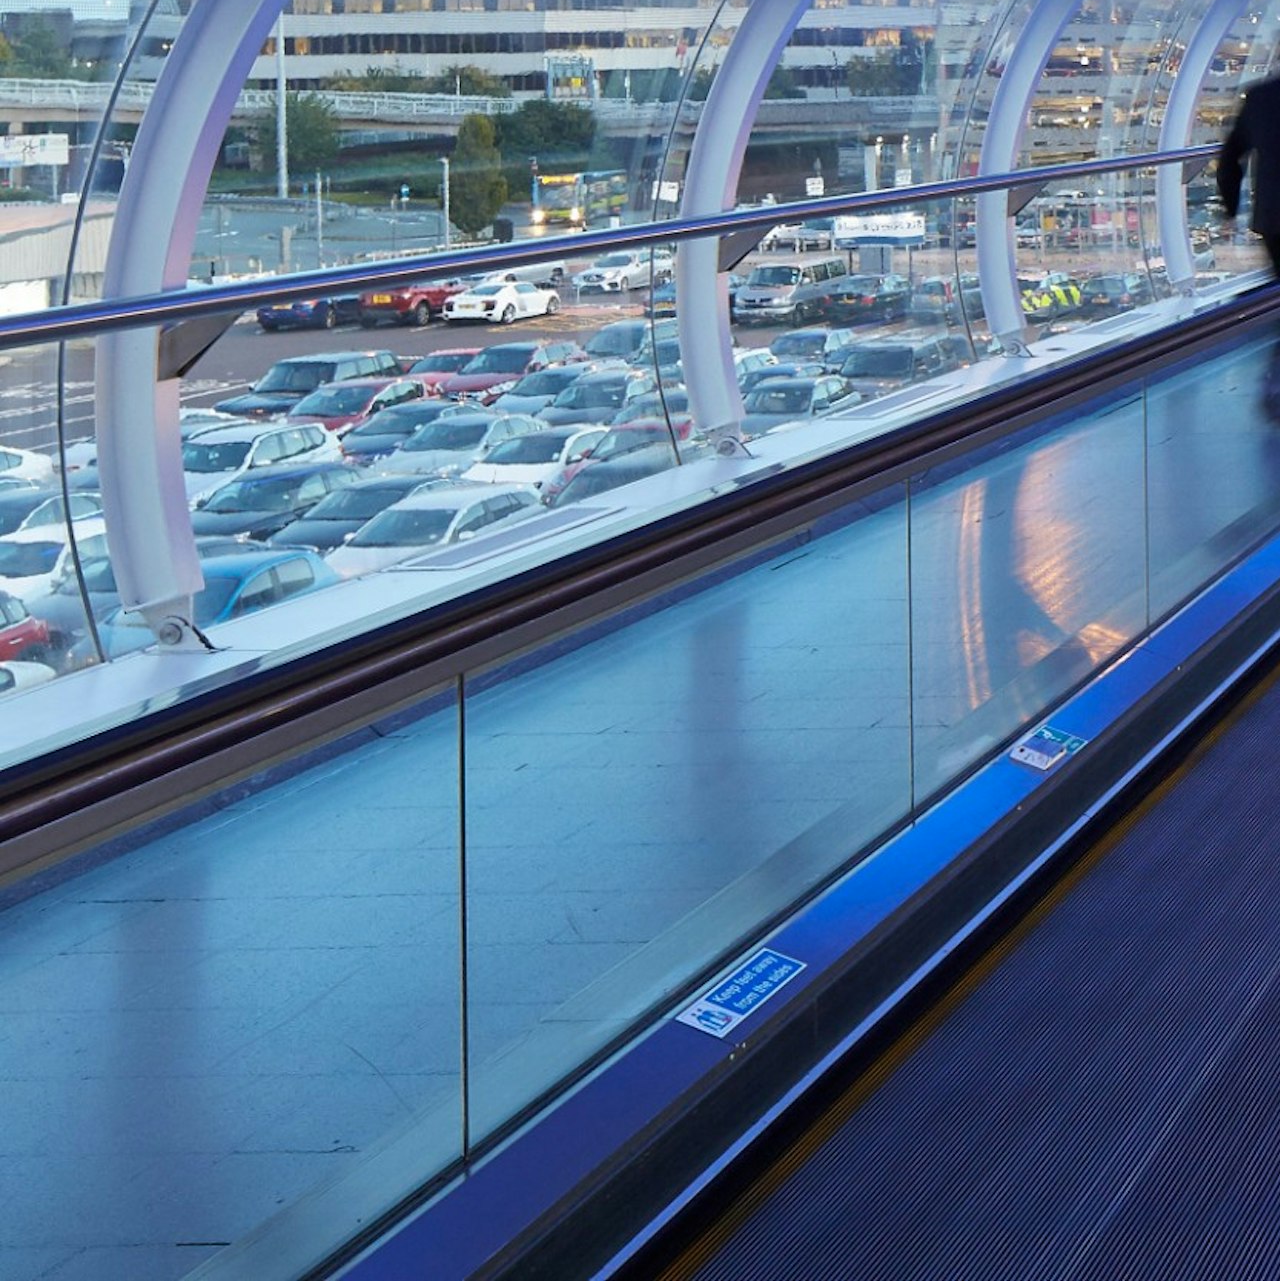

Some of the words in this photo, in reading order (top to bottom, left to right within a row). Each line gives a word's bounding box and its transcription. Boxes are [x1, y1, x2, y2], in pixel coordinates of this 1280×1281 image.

[712, 984, 742, 1004] Keep
[734, 969, 757, 986] feet
[752, 954, 779, 973] away
[732, 991, 760, 1009] from
[752, 980, 773, 994] the
[768, 963, 793, 983] sides
